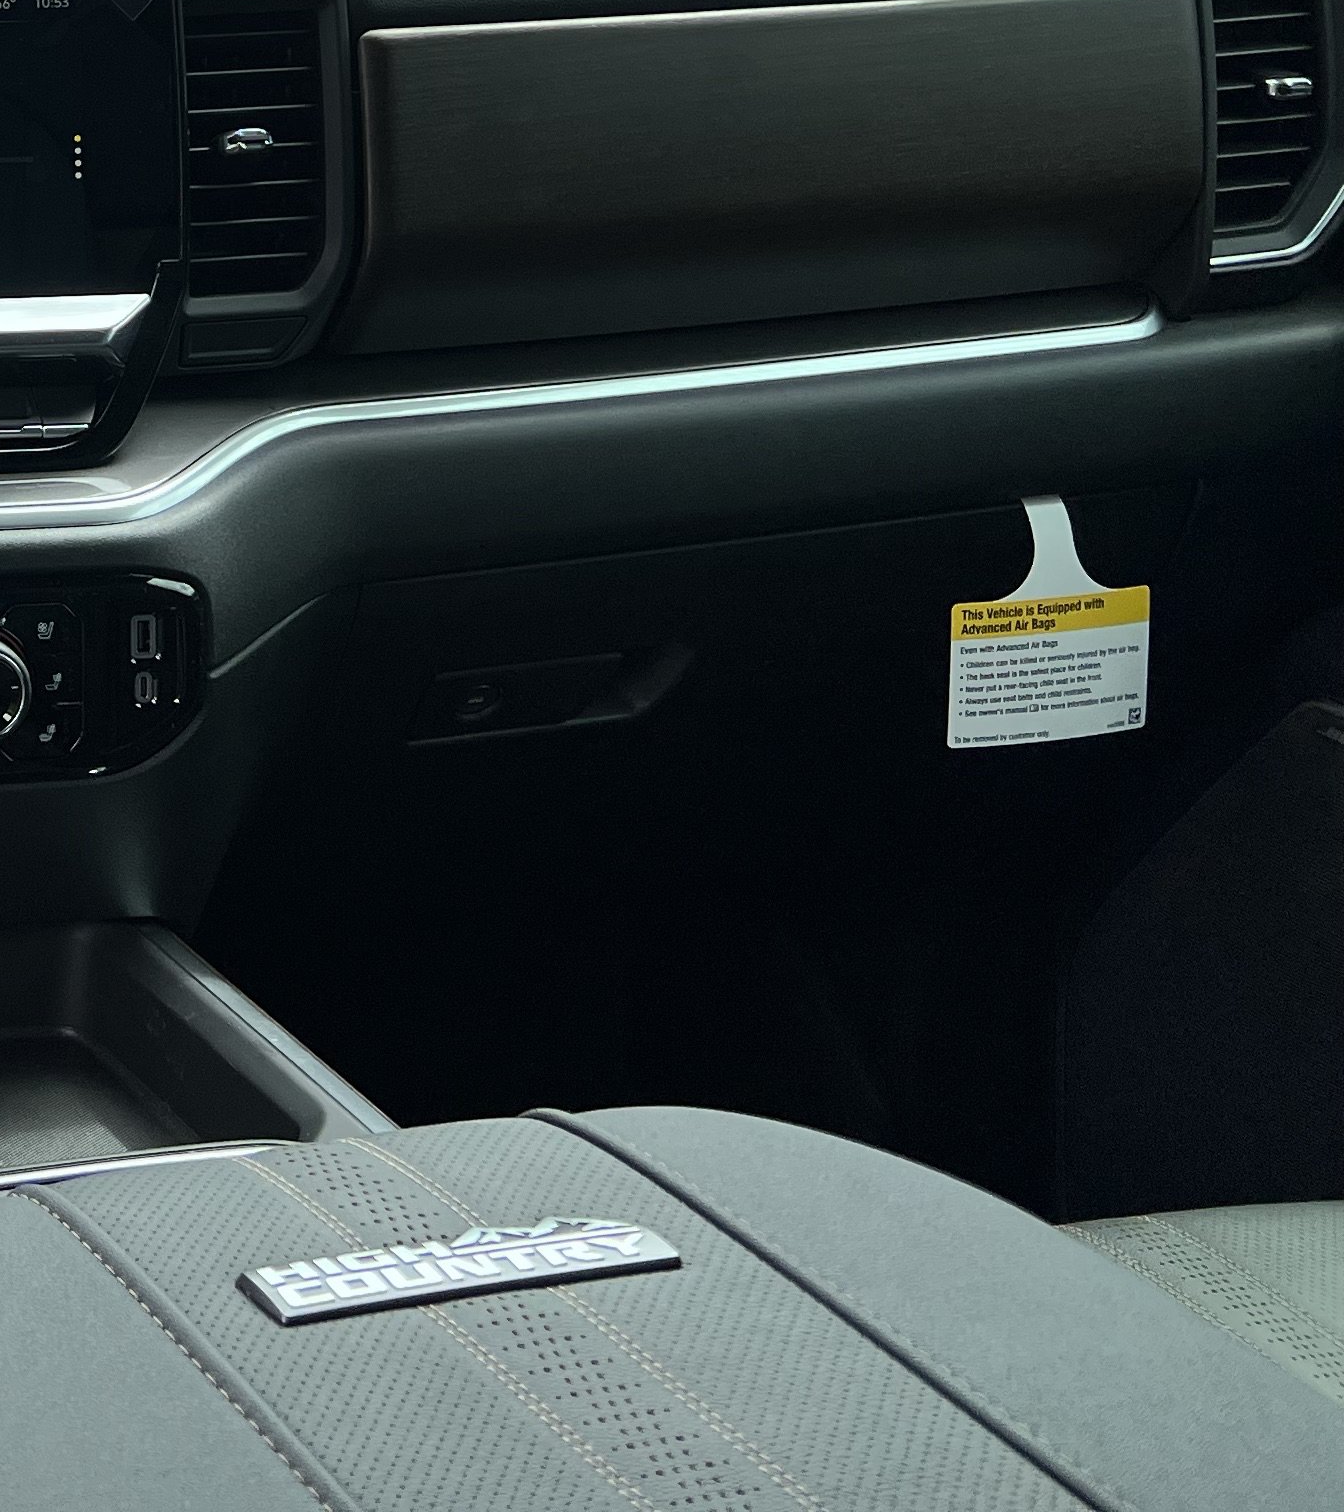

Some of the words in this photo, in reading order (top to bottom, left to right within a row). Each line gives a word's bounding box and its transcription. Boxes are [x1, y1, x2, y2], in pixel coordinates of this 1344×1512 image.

[961, 608, 984, 621] This
[986, 605, 1023, 619] Vehicle
[1025, 604, 1035, 616] is
[1037, 599, 1082, 616] Equipped
[1084, 597, 1105, 609] with
[961, 620, 1012, 635] Advanced
[1014, 619, 1030, 631] Air
[1031, 618, 1056, 631] Bags
[960, 646, 978, 655] Even
[979, 645, 995, 653] with
[996, 641, 1030, 653] Advanced
[1030, 641, 1040, 649] Air
[1041, 640, 1059, 649] Bags
[255, 1239, 454, 1287] HIGH
[276, 1231, 646, 1308] COUNTRY
